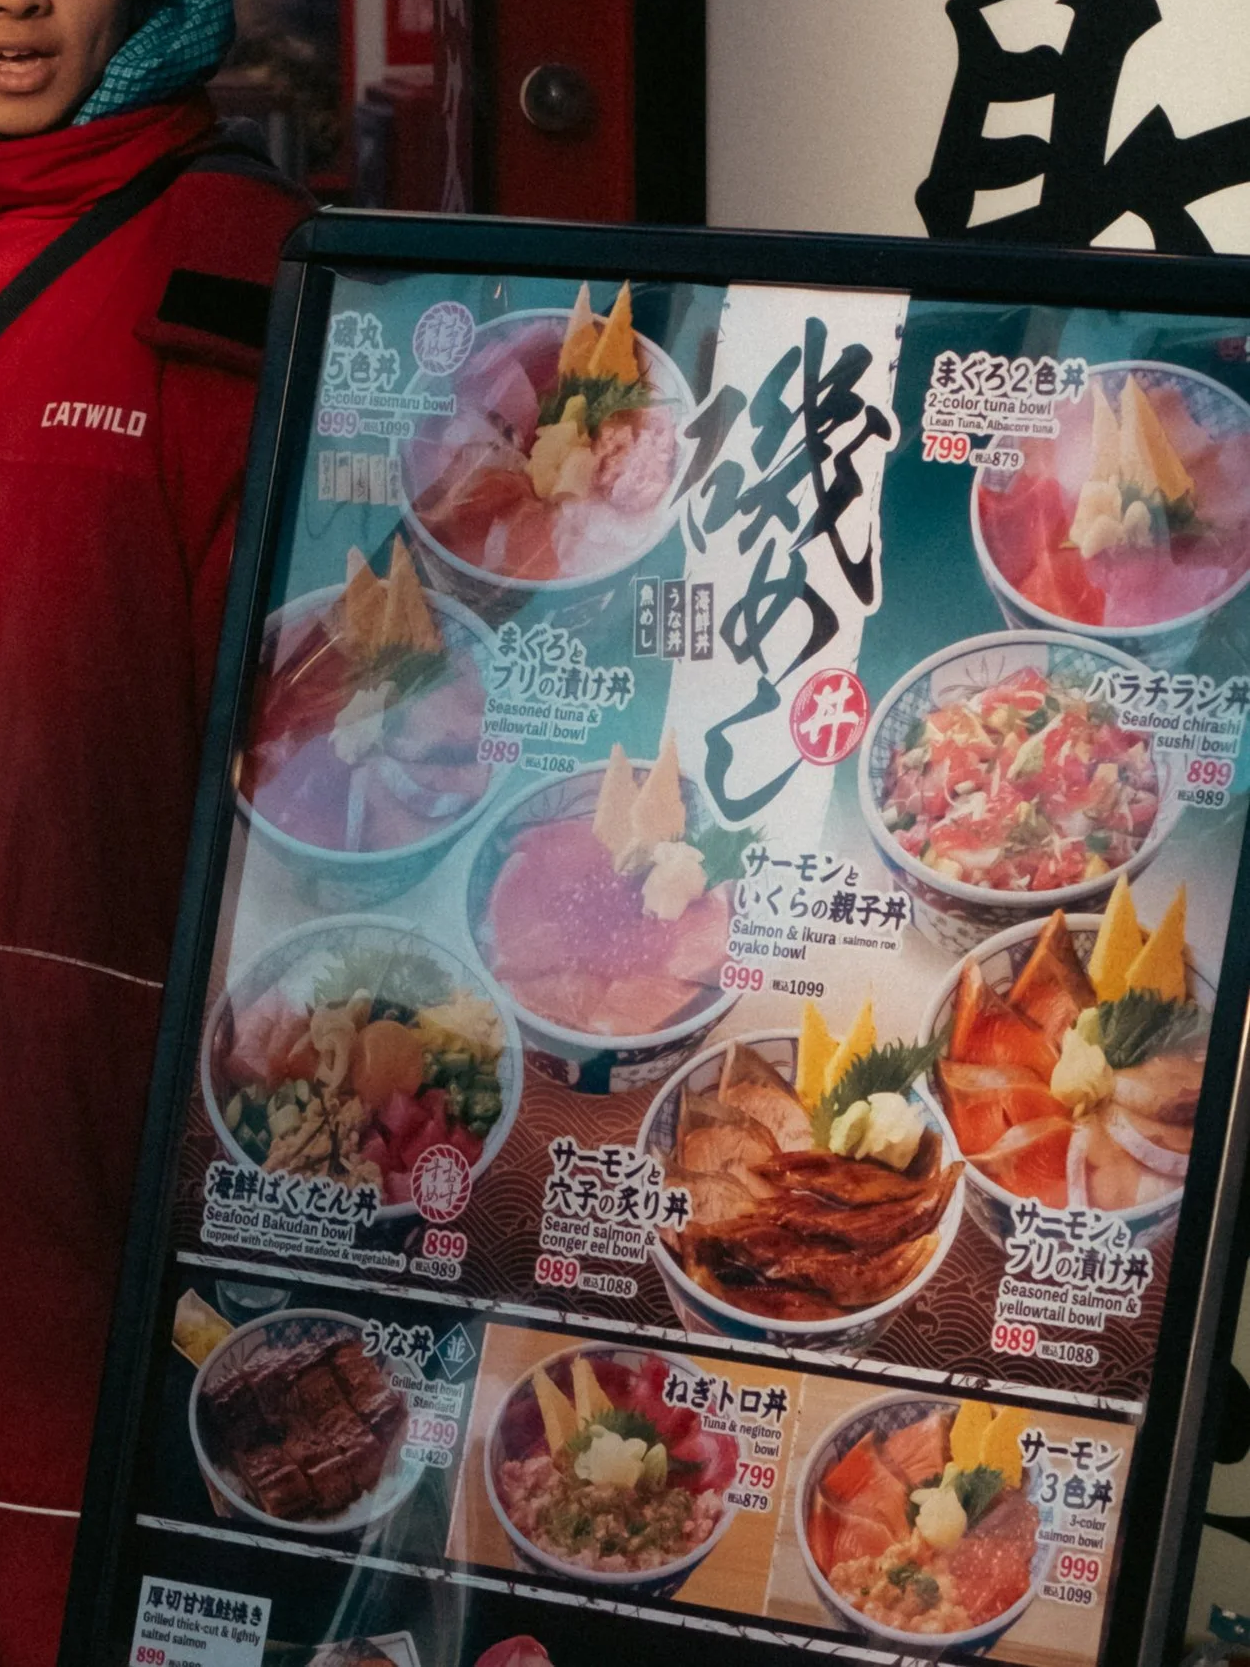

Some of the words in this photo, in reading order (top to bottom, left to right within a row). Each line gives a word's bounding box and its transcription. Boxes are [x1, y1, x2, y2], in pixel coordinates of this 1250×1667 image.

[936, 357, 1085, 398] まぐろ2色丼
[424, 396, 454, 412] bowl
[928, 392, 978, 410] 2-color
[984, 397, 1015, 413] tuna
[1019, 401, 1052, 415] bowl
[41, 402, 147, 437] CATWILD
[320, 412, 357, 434] 999
[986, 420, 1030, 432] Albacore
[923, 436, 967, 460] 799
[639, 585, 654, 648] 魚めし
[667, 588, 682, 651] うな丼
[694, 588, 711, 654] 海鮮丼
[499, 628, 585, 665] まぐろと
[493, 664, 632, 705] ブリの漬け丼
[1089, 673, 1250, 717] バラチラシ丼
[487, 699, 550, 718] Seasoned
[554, 708, 584, 722] tuna
[587, 710, 598, 723] &
[801, 680, 859, 759] 丼
[1121, 711, 1180, 730] Seafood
[1183, 718, 1241, 735] chirashi
[483, 718, 547, 737] yellowtail
[553, 724, 585, 740] bowl
[480, 740, 519, 762] 989
[1156, 734, 1196, 750] sushi
[1202, 738, 1236, 754] bowl
[1187, 760, 1231, 786] 899
[745, 847, 859, 887] サーモンと
[738, 885, 906, 931] いくらの親子丼
[732, 921, 783, 938] Salmon
[786, 926, 798, 939] &
[802, 927, 836, 945] ikura
[729, 939, 769, 957] oyako
[773, 943, 806, 960] bowl
[723, 965, 763, 991] 999
[553, 1141, 661, 1186] サーモンと
[208, 1165, 377, 1223] 海鮮ばくだん丼
[546, 1178, 688, 1227] 穴子の炙り丼
[207, 1206, 259, 1228] Seafood
[262, 1216, 319, 1235] Bakudan
[322, 1226, 353, 1242] bowl
[544, 1216, 589, 1237] Seared
[593, 1226, 641, 1244] salmon
[645, 1233, 655, 1245] &
[1016, 1203, 1126, 1247] サーモンと
[241, 1234, 260, 1246] with
[263, 1237, 302, 1254] chopped
[305, 1243, 339, 1259] seafood
[342, 1250, 349, 1259] &
[424, 1234, 465, 1258] 899
[542, 1234, 587, 1254] conger
[590, 1240, 609, 1255] eel
[612, 1244, 645, 1260] bowl
[538, 1257, 578, 1284] 989
[1007, 1240, 1149, 1289] ブリの漬け丼
[1002, 1282, 1068, 1303] Seasoned
[1072, 1294, 1122, 1312] salmon
[1126, 1300, 1138, 1314] &
[997, 1299, 1065, 1323] yellowtail
[1068, 1312, 1102, 1328] bowl
[363, 1322, 431, 1364] うな丼
[994, 1325, 1035, 1352] 989
[392, 1377, 422, 1392] Grilled
[424, 1381, 438, 1393] eel
[665, 1374, 787, 1423] ねぎトロ丼
[409, 1419, 455, 1442] 1299
[703, 1416, 726, 1430] Tuna
[728, 1421, 737, 1432] &
[740, 1424, 782, 1440] negitoro
[754, 1442, 779, 1456] bowl
[1021, 1431, 1121, 1474] サーモン
[738, 1463, 775, 1489] 799
[1041, 1473, 1113, 1514] 3色丼
[1070, 1515, 1106, 1531] 3-color
[1038, 1529, 1076, 1545] salmon
[1078, 1534, 1103, 1548] bowl
[1060, 1555, 1099, 1582] 999
[141, 1629, 170, 1643] salted
[172, 1634, 206, 1650] salmon
[143, 1611, 174, 1628] Grilled
[177, 1617, 219, 1637] thick-cut
[221, 1625, 229, 1638] &
[231, 1629, 260, 1647] lightly
[137, 1646, 165, 1666] 899
